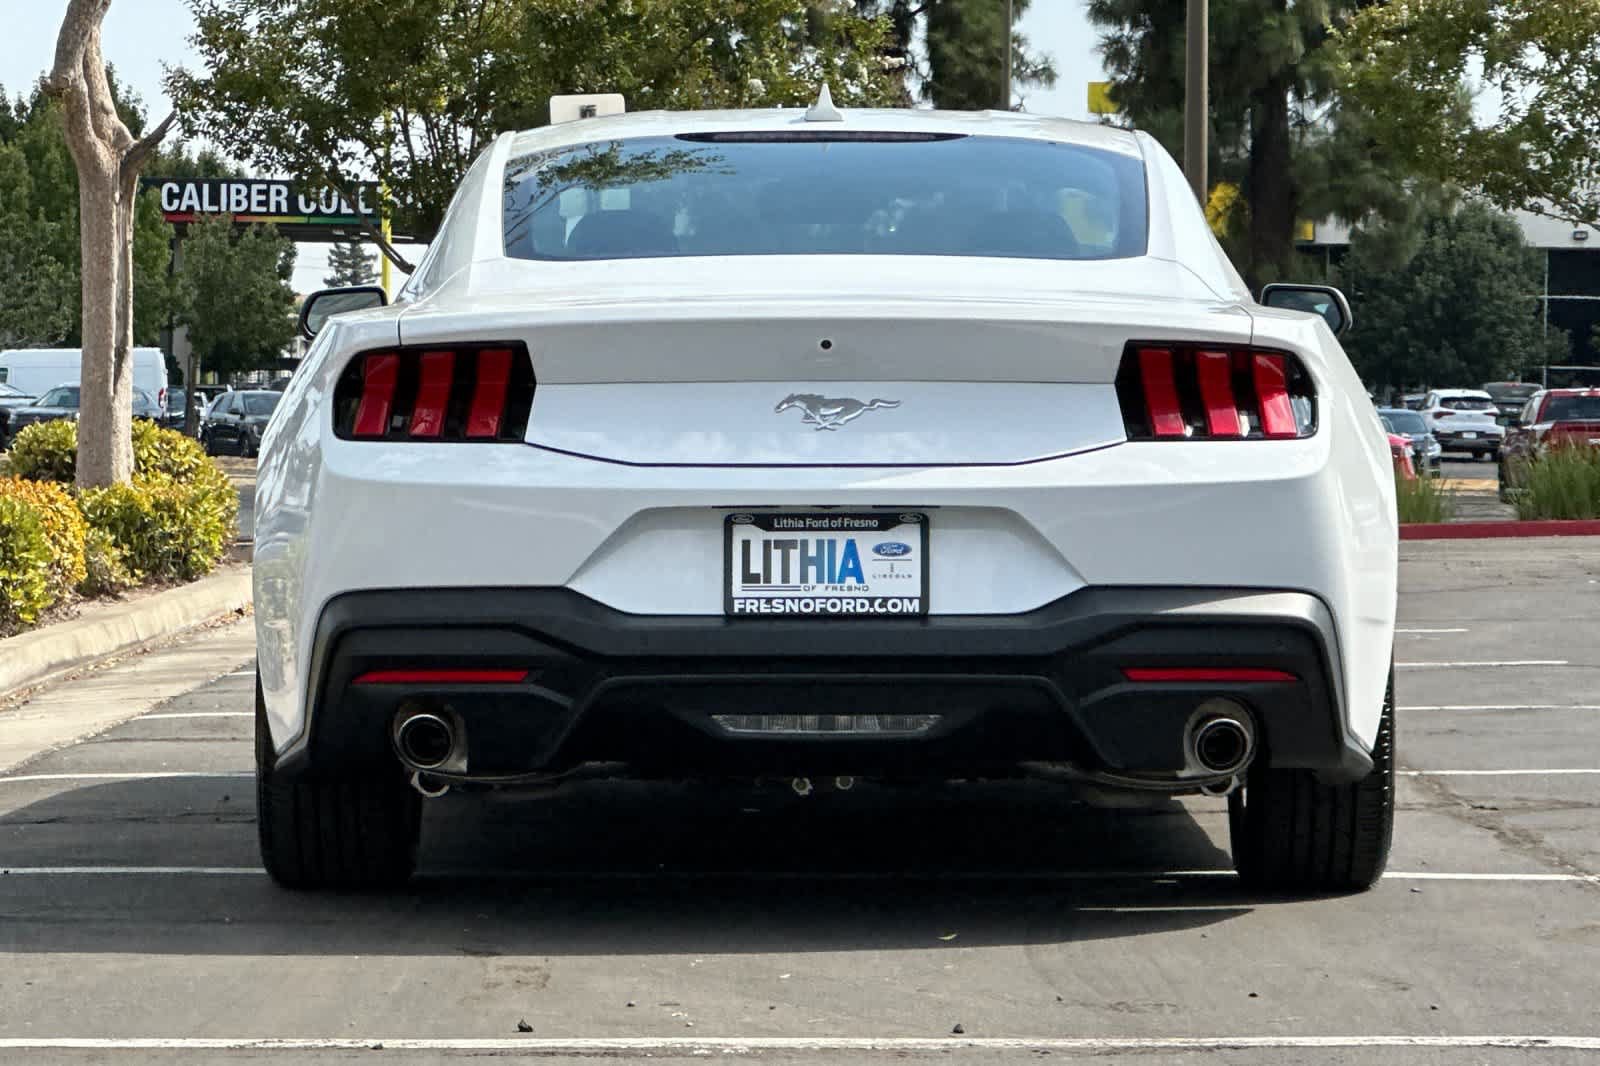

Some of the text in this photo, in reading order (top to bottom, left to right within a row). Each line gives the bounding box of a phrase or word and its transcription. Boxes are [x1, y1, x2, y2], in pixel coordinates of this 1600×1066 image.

[161, 183, 288, 213] CALIBER
[774, 518, 878, 528] Lithia Ford of Fresno
[877, 543, 907, 556] Ford
[741, 539, 865, 584] LITHIA
[733, 598, 920, 613] FRESNOFORD.COM
